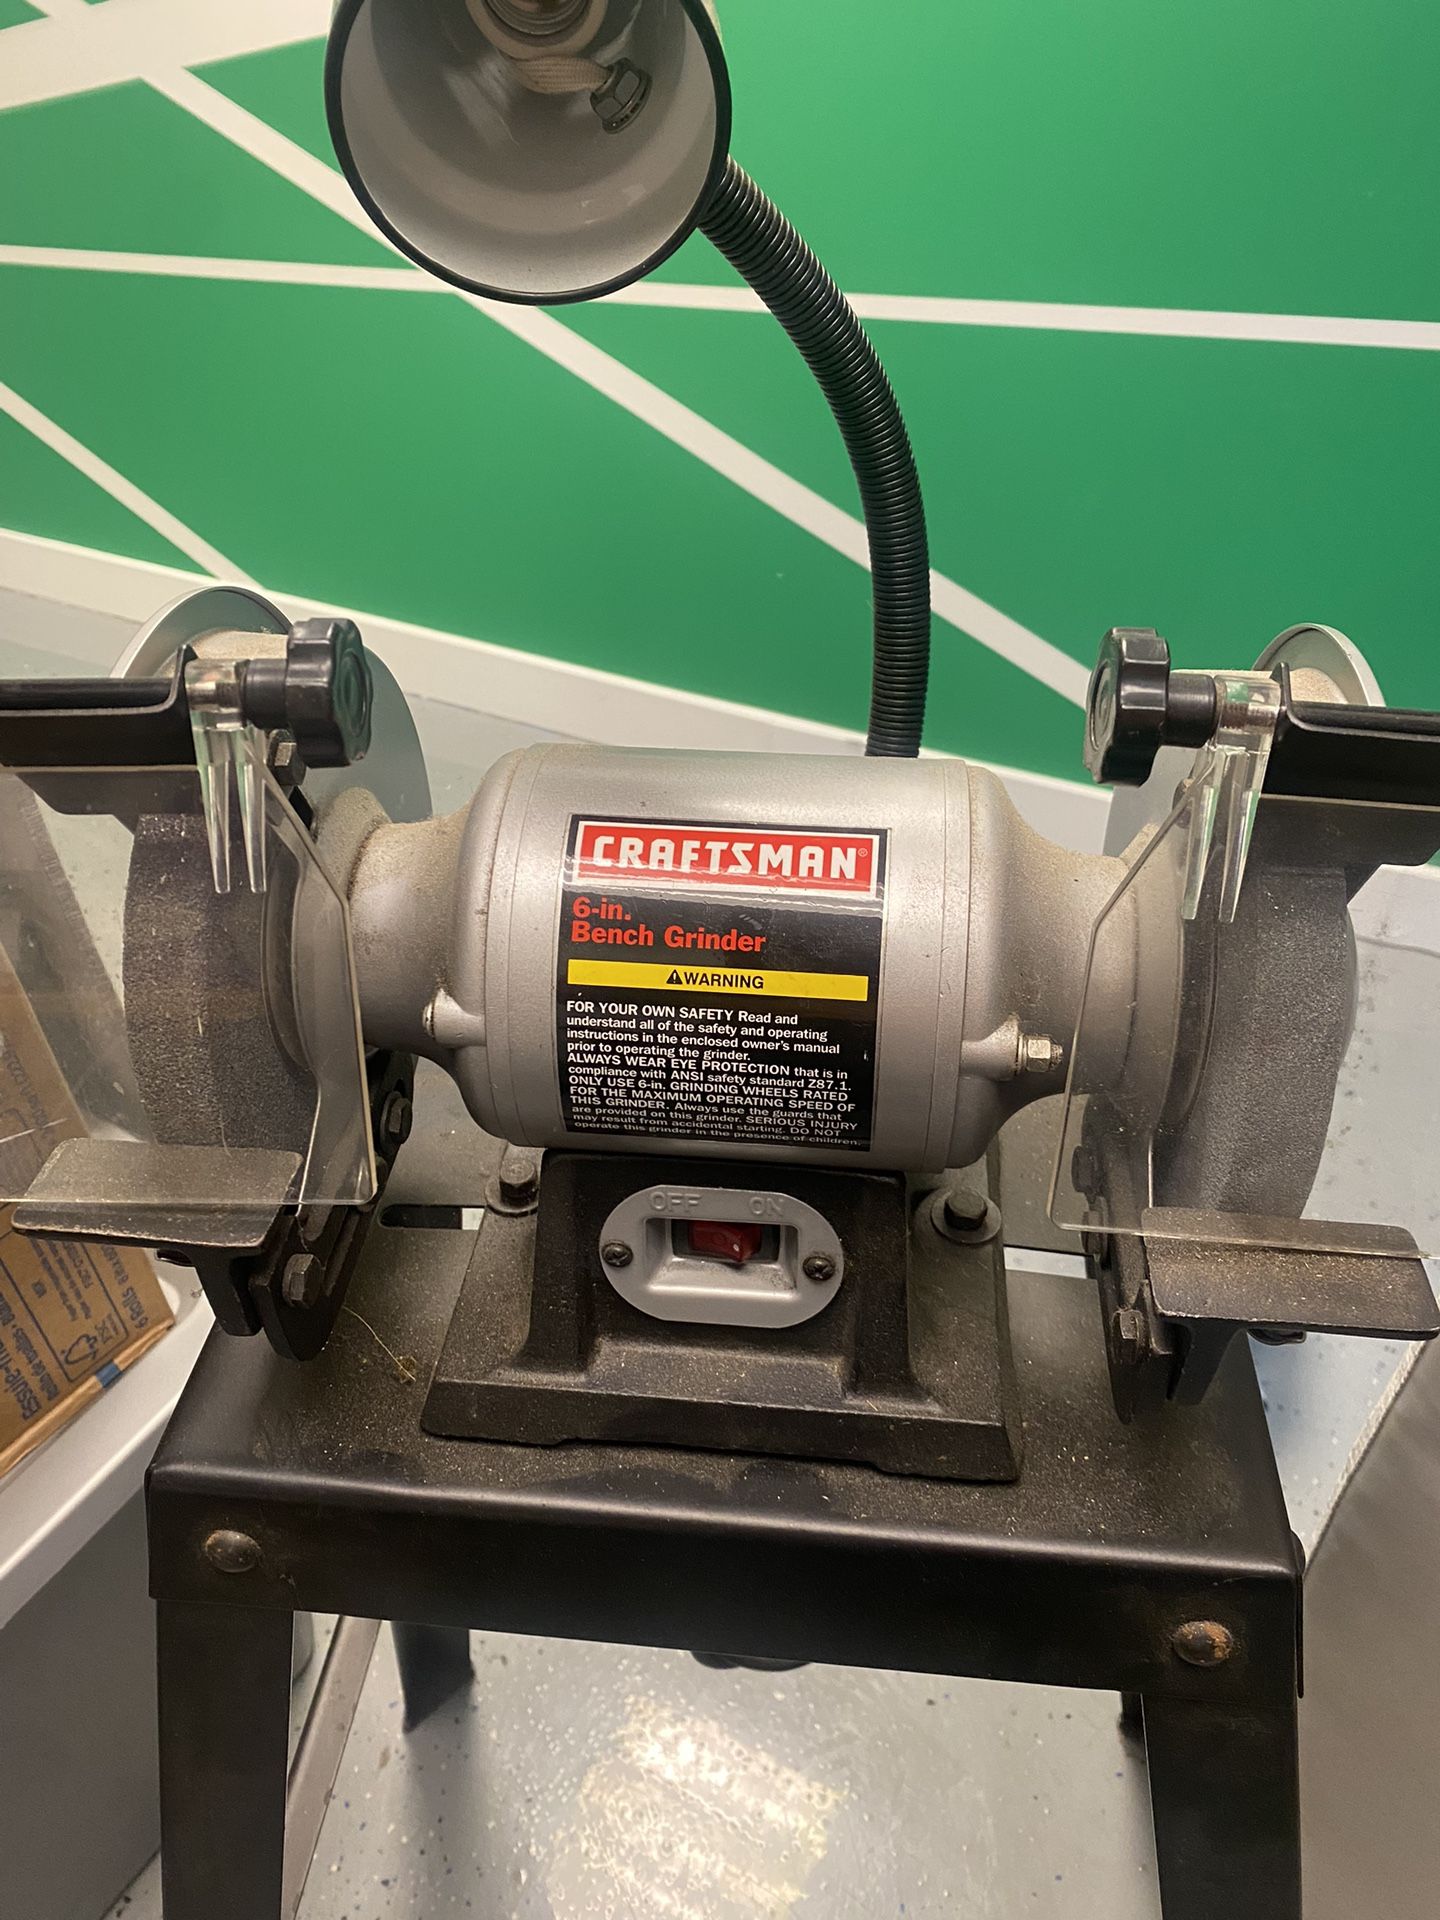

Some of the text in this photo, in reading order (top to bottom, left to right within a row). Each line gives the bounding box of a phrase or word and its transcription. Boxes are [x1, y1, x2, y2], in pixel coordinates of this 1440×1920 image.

[572, 896, 631, 921] 6-in.
[571, 921, 767, 952] Bench Grinder
[684, 972, 764, 990] WARNING
[566, 1001, 798, 1025] FOR YOUR OWN SAFETY Read and
[566, 1016, 828, 1042] understand all of the safety and operating
[566, 1028, 840, 1054] instructions in the enclosed owner's manual
[568, 1042, 750, 1060] prior to operating the grinder.
[567, 1053, 848, 1079] ALWAYS WEAR EYE PROTECTION that is in
[568, 1066, 852, 1091] compliance with ANSI safety standard Z87.1.
[569, 1075, 848, 1101] ONLY USE 6-in. GRINDING WHEELS RATED
[570, 1086, 856, 1112] FOR THE MAXIMUM OPERATING SPEED OF
[570, 1096, 601, 1105] THIS
[606, 1098, 670, 1110] GRINDER.
[674, 1102, 718, 1113] Always
[749, 1108, 769, 1116] the
[772, 1109, 814, 1118] guards
[818, 1112, 842, 1120] that
[596, 1108, 646, 1117] provided
[696, 1114, 741, 1122] grinder.
[746, 1116, 806, 1126] SERIOUS
[810, 1121, 858, 1130] INJURY
[573, 1114, 598, 1122] may
[672, 1120, 733, 1130] accidental
[737, 1125, 786, 1134] starting.
[651, 1191, 784, 1216] OFF ON
[121, 1286, 145, 1321] Rolls
